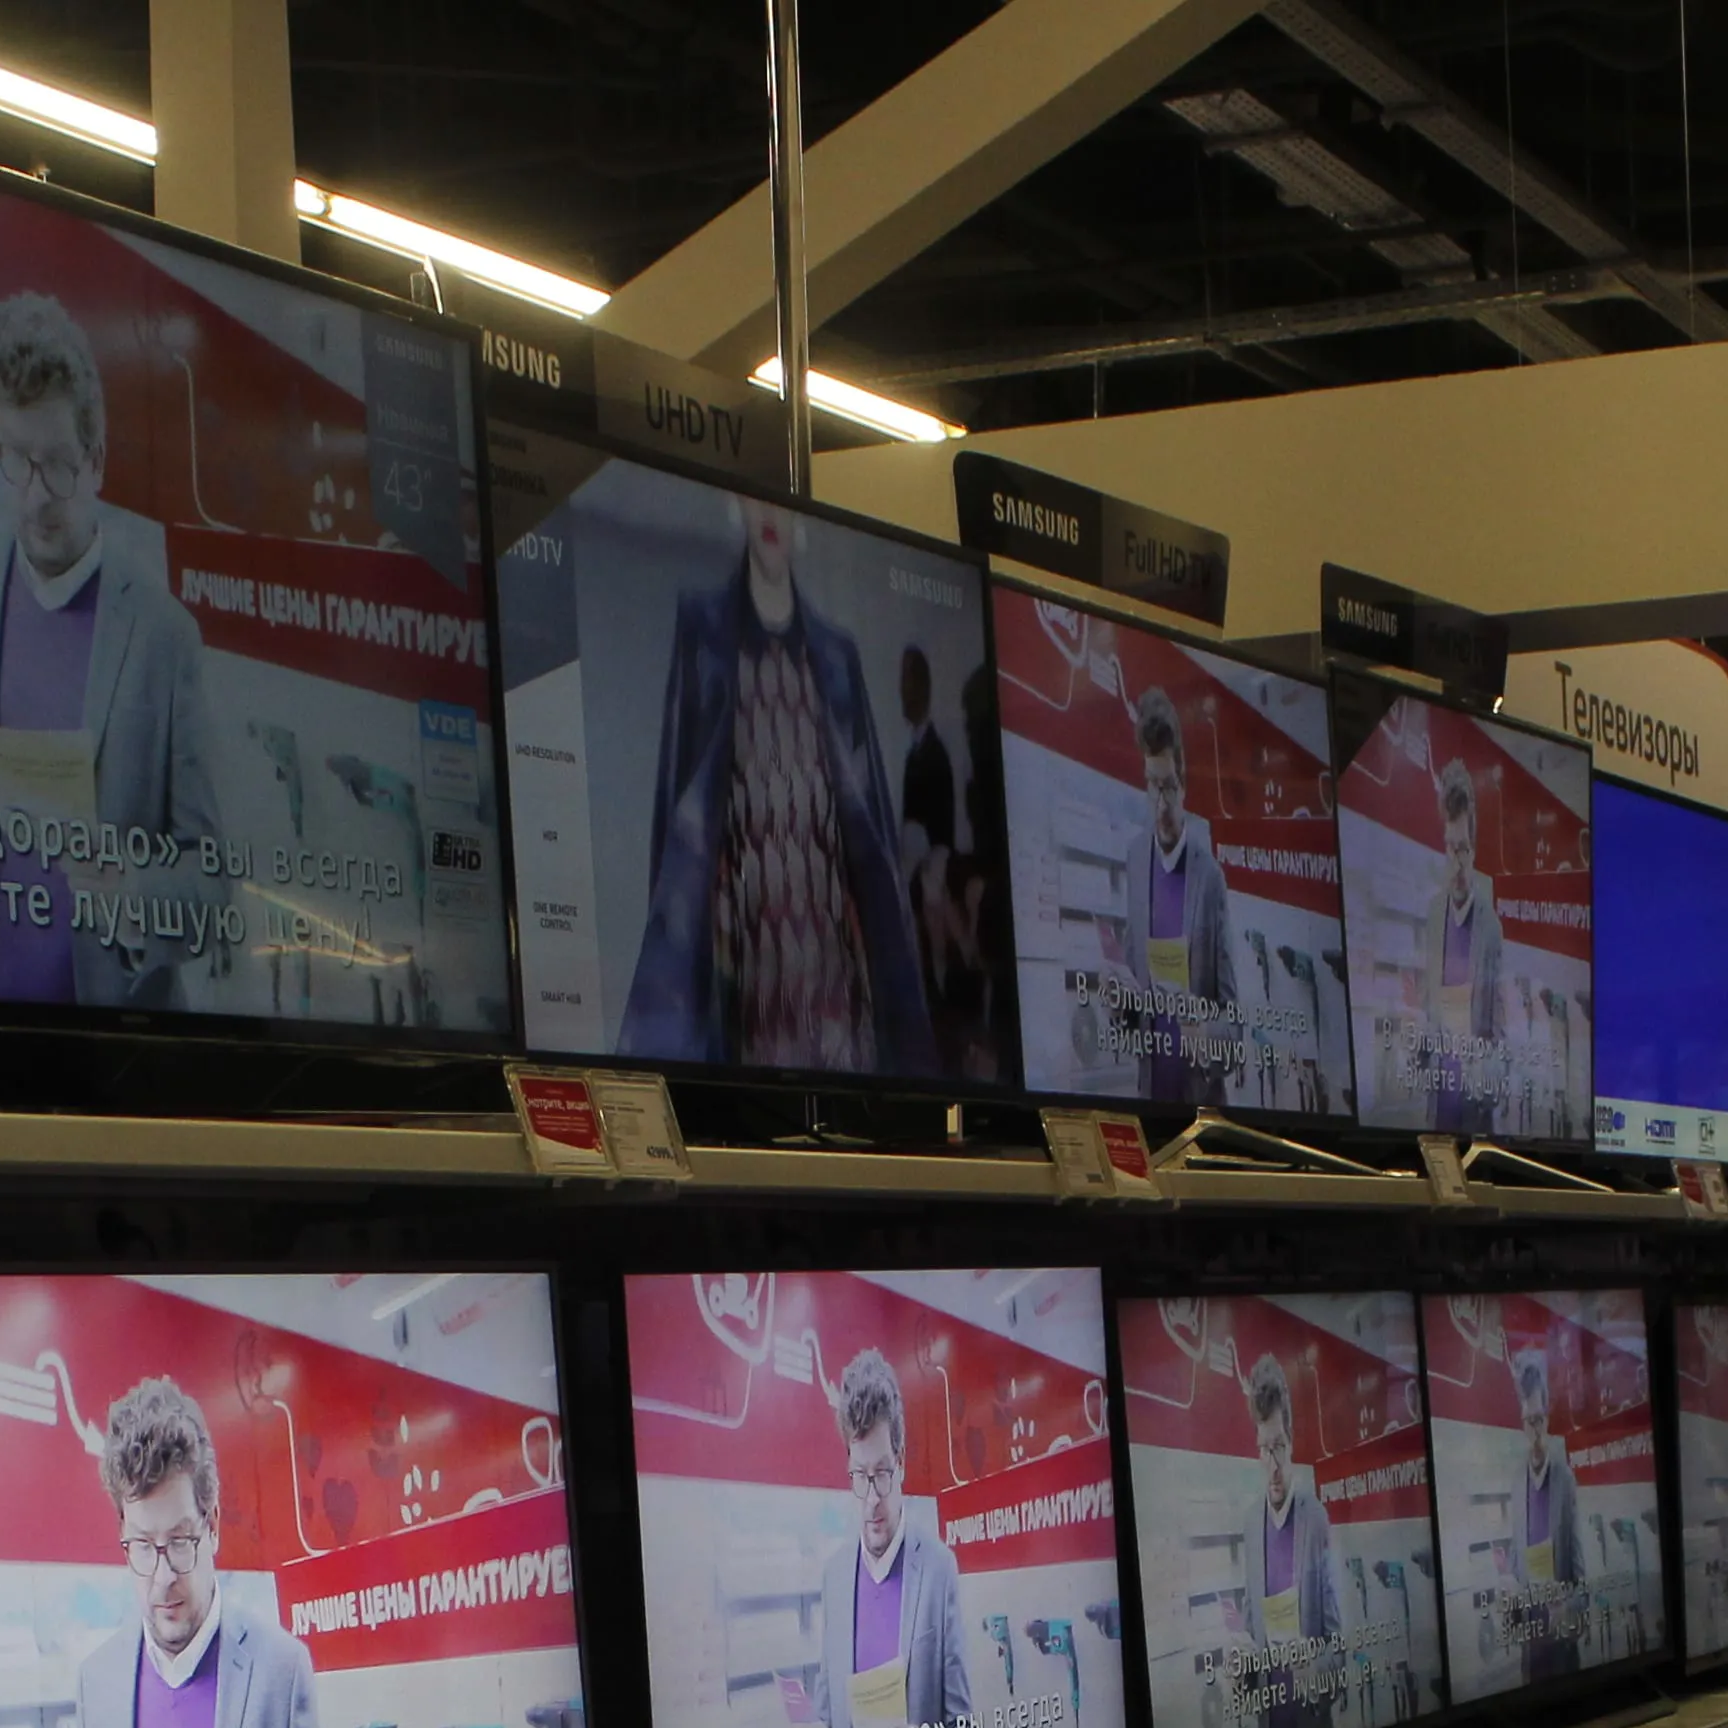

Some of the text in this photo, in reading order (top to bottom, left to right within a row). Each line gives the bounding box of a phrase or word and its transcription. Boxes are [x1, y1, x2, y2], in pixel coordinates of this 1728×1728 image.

[644, 381, 744, 459] UHD TV
[992, 491, 1081, 547] SAMSUNG
[538, 535, 564, 567] TV
[1124, 530, 1158, 577] Full
[1159, 544, 1187, 586] HD
[181, 567, 255, 619] ЛУЧШИЕ
[258, 581, 322, 631] ЦЕНЫ
[888, 566, 964, 610] SAMSUNG
[1337, 596, 1399, 638] SAMSUNG
[423, 710, 474, 739] VDE
[1554, 660, 1700, 787] Телевизоры
[200, 834, 254, 878] вы
[273, 847, 403, 901] всегда
[451, 847, 483, 872] HD
[70, 885, 248, 955] лучшую
[1075, 971, 1089, 1008] В
[1097, 974, 1220, 1026] «Эльдорадо»
[945, 1512, 986, 1547] ЛУЧШИЕ
[986, 1503, 1020, 1544] ЦЕНЫ
[291, 1543, 573, 1637] ЛУЧШИЕ ЦЕНЫ ГАРАНТИРУЕ
[1203, 1651, 1216, 1685] В
